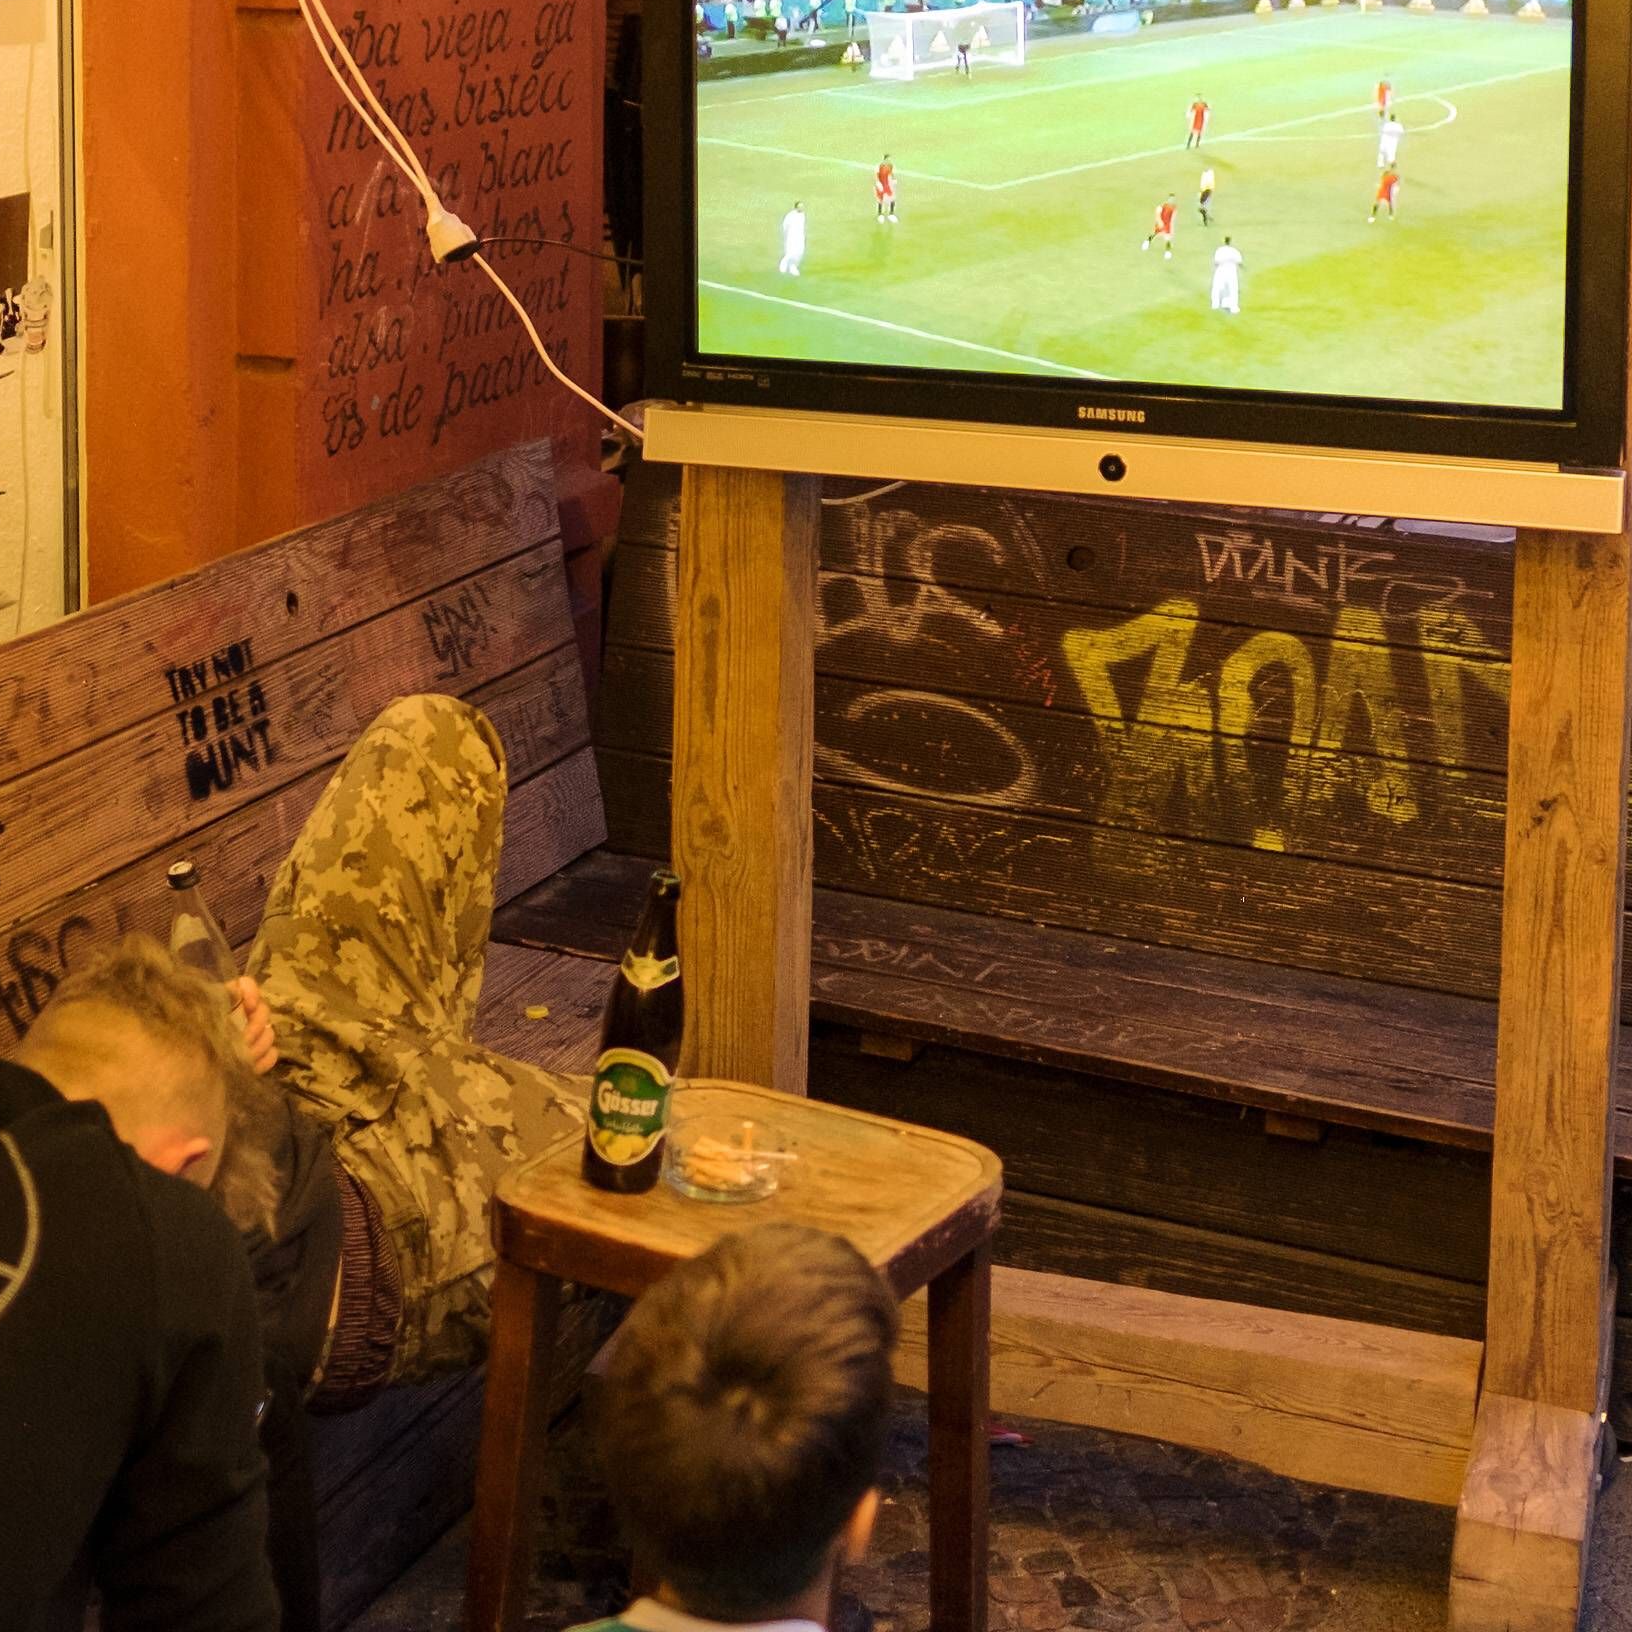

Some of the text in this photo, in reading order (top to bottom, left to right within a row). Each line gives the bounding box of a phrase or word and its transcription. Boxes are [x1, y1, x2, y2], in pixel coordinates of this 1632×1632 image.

[530, 0, 576, 70] ga
[472, 129, 574, 212] planc
[379, 366, 425, 437] de
[1077, 405, 1146, 424] SAMSUNG
[164, 636, 253, 705] TRY NOT
[175, 680, 267, 747] TO BE A
[597, 1079, 659, 1117] Gösser
